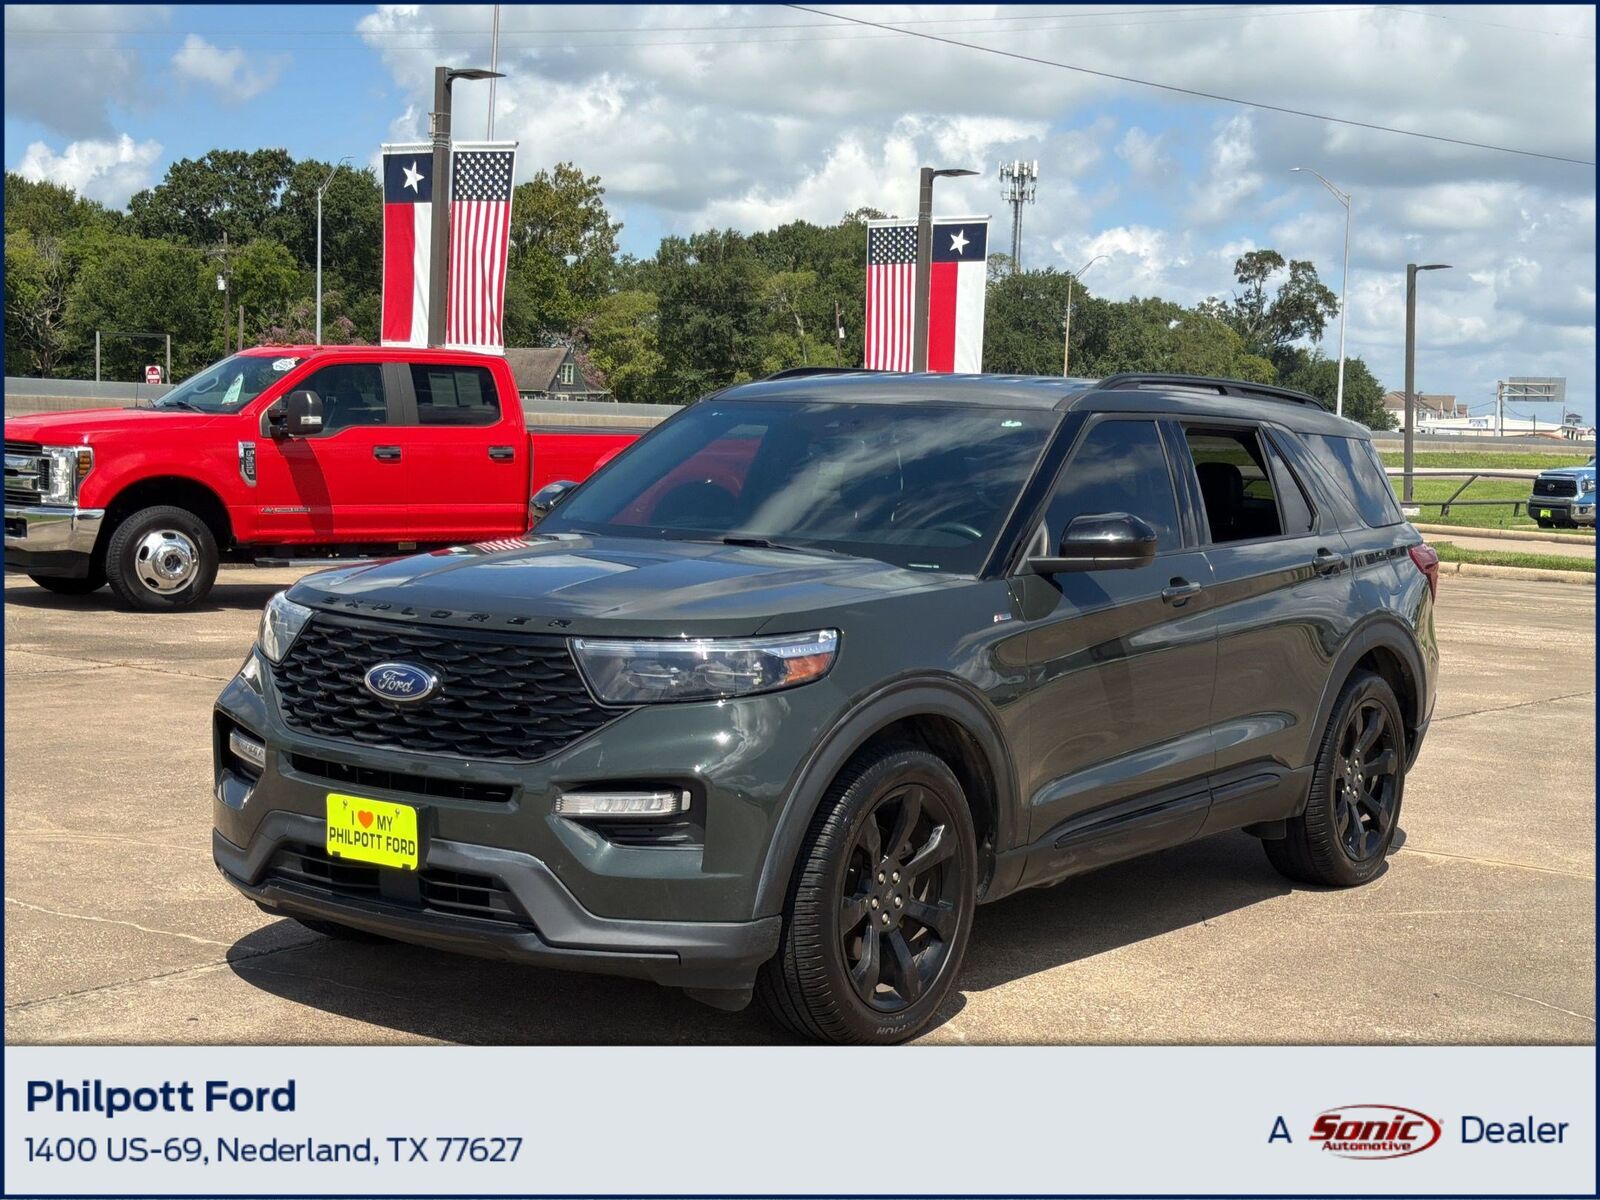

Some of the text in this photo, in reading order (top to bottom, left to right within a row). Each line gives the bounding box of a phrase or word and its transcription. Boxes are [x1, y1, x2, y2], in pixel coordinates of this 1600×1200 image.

[321, 596, 573, 628] EXPLORER
[378, 669, 415, 693] Ford
[351, 810, 393, 832] I MY
[329, 826, 416, 856] PHILPOTT FORD
